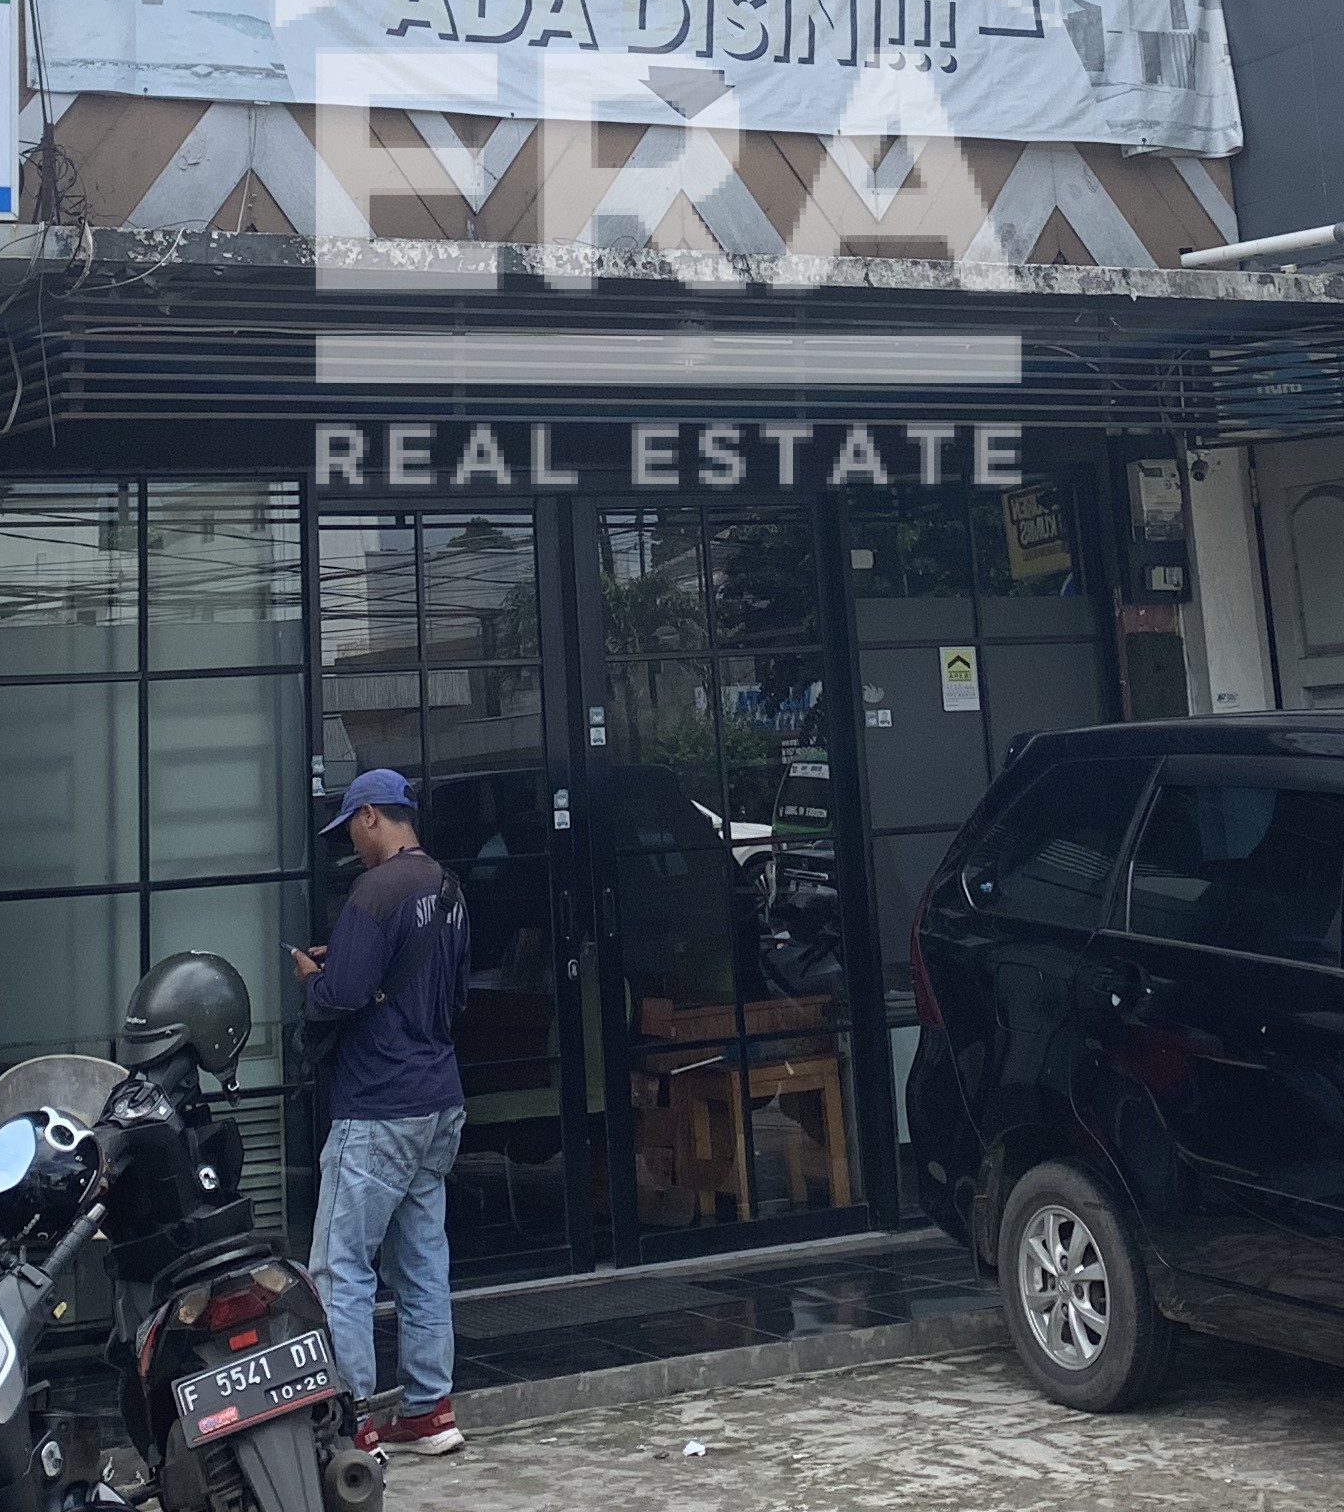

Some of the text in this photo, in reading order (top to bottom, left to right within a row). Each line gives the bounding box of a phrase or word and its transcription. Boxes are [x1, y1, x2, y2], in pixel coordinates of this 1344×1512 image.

[184, 1337, 319, 1411] F 5541 DT
